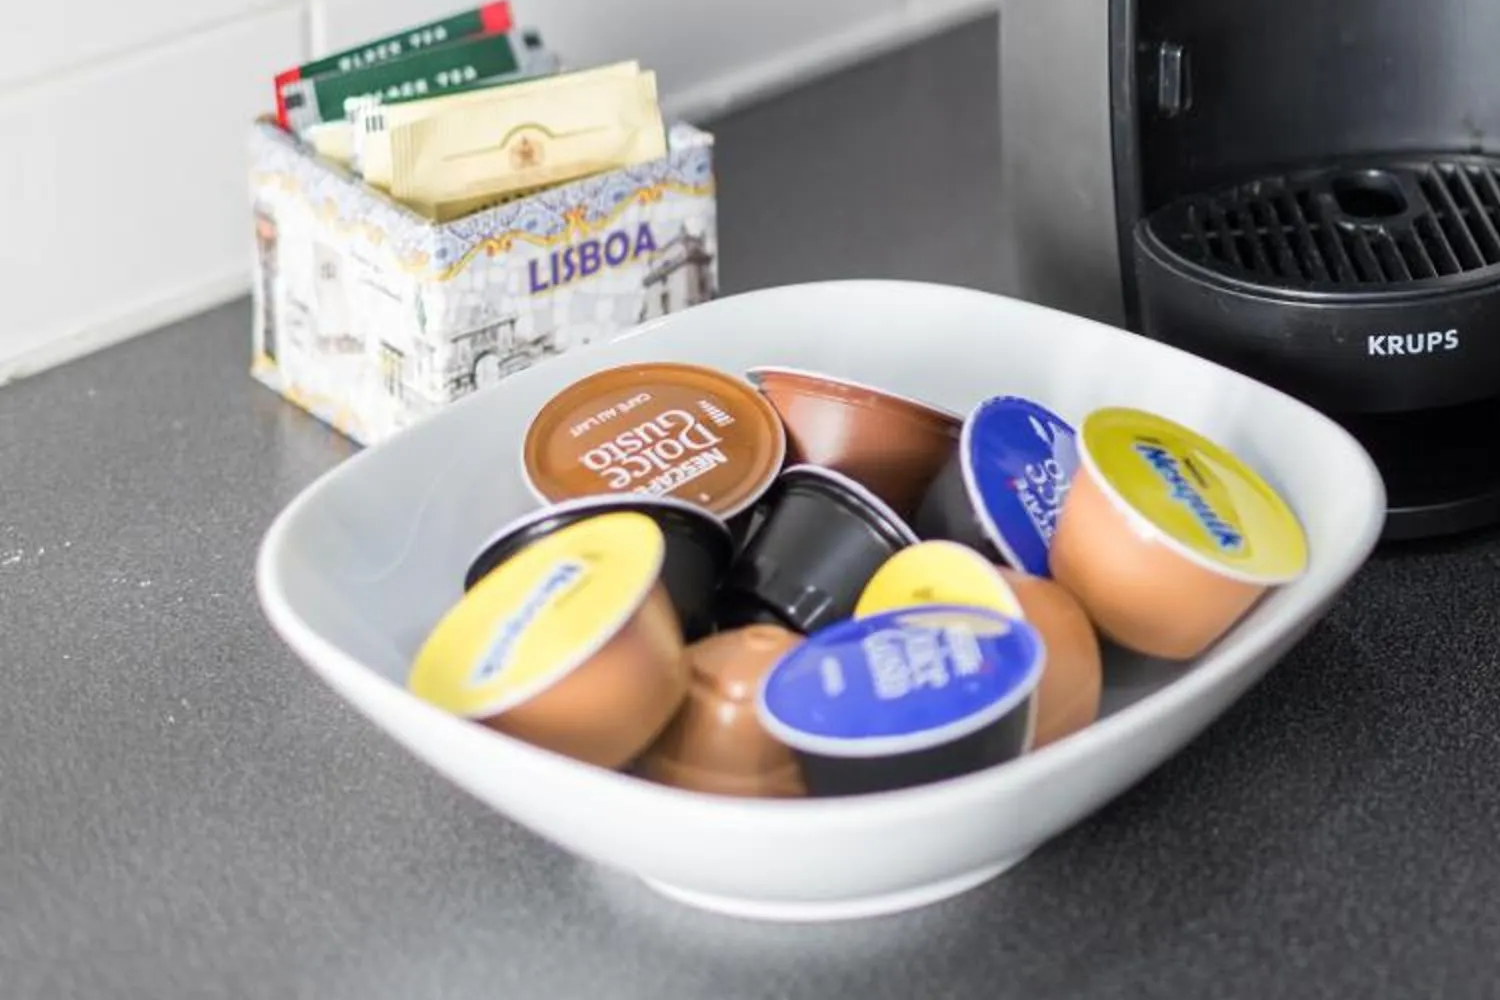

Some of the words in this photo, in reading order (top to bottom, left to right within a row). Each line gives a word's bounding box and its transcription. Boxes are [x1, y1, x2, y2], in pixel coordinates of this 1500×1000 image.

[529, 221, 657, 295] LISBOA
[1367, 328, 1460, 356] KRUPS
[579, 409, 697, 472] Gusto
[600, 422, 723, 490] Dolce
